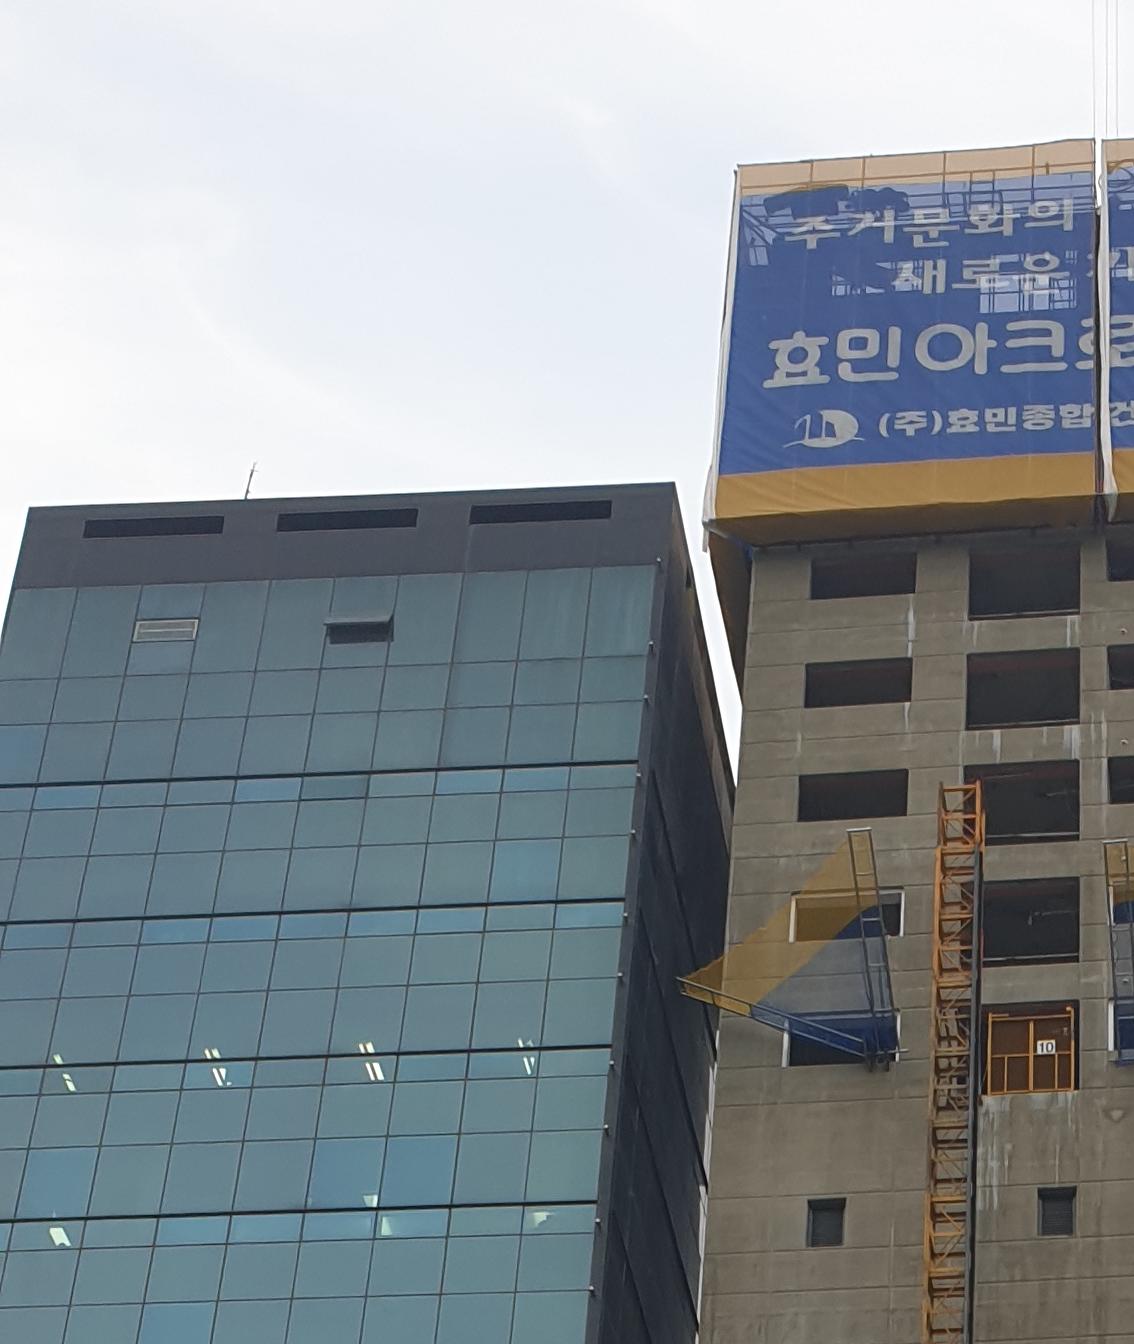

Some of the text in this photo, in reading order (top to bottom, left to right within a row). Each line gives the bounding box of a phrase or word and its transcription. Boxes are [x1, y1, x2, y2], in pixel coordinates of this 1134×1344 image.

[785, 198, 1074, 250] 주거문화의
[890, 251, 1069, 298] 새로운
[1039, 1042, 1054, 1053] 10
